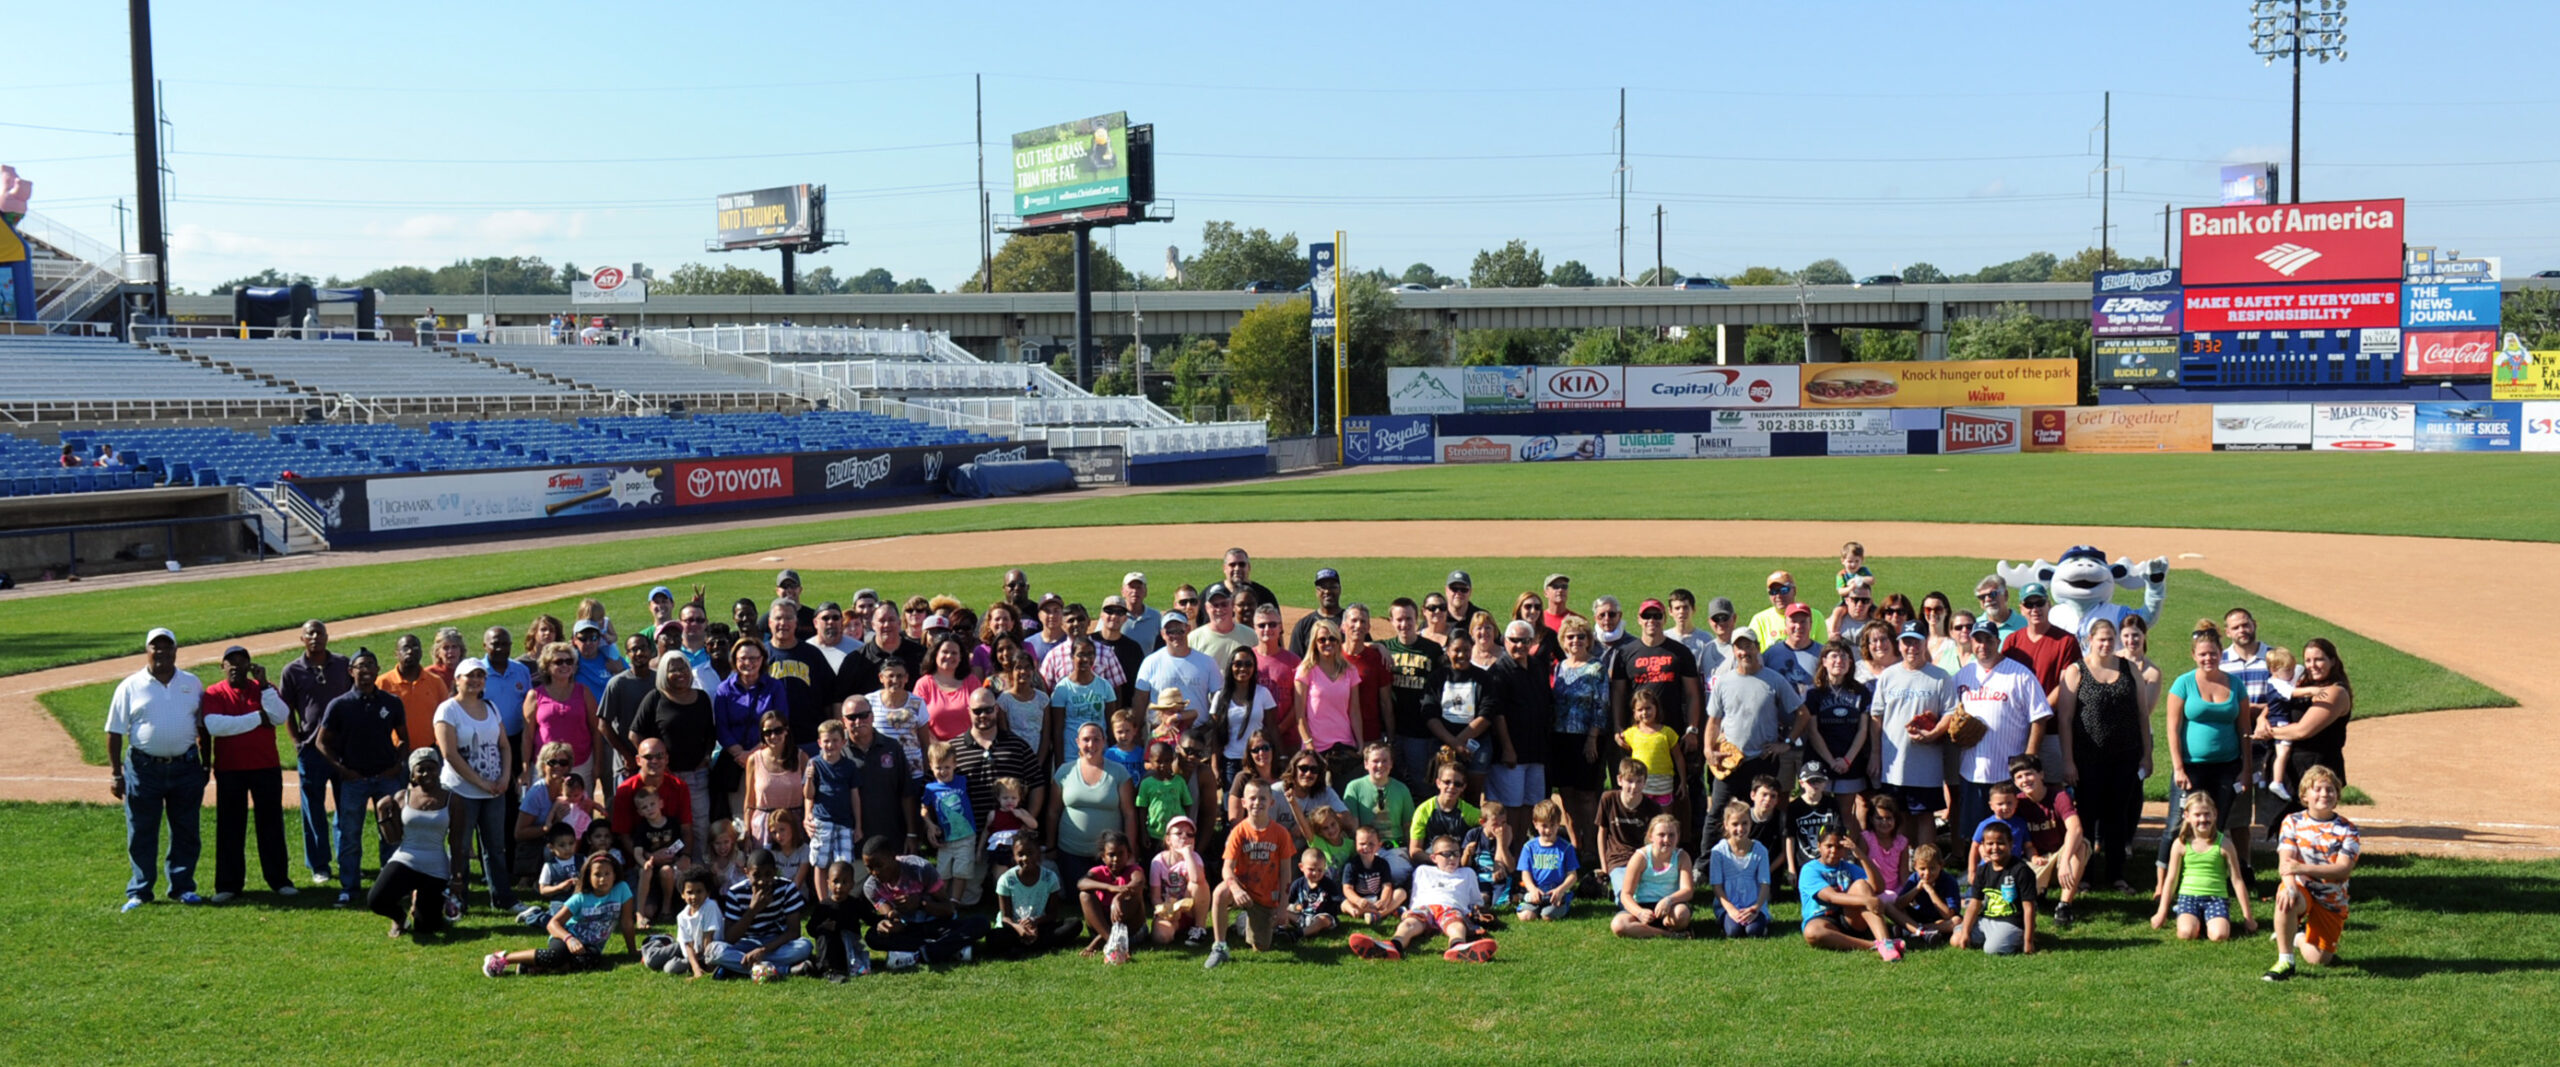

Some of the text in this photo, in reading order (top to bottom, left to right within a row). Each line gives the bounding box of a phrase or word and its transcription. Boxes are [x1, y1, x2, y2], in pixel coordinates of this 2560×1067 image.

[1016, 141, 1087, 169] CUT THE GRASS.
[1017, 163, 1078, 188] TRIM THE FAT.
[719, 203, 787, 231] INTO TRIUMPH.
[2189, 205, 2394, 236] Bank of America
[2435, 263, 2479, 273] MCM
[2101, 270, 2172, 291] BLUE ROCKS
[2411, 286, 2439, 298] THE
[2187, 292, 2395, 309] MAKE SAFETY EVERYONE'S
[2410, 298, 2452, 310] NEWS
[2108, 314, 2126, 325] Sign
[2140, 313, 2165, 323] Today
[2228, 308, 2352, 322] RESPONSIBILITY
[2408, 310, 2476, 325] JOURNAL
[2271, 331, 2289, 339] BALL
[2300, 330, 2325, 339] STRIKE
[2336, 329, 2351, 338] OUT
[2193, 339, 2222, 353] 3:32
[1466, 373, 1502, 385] MONEY
[1901, 366, 2072, 383] Knock hunger out of the park
[2114, 369, 2158, 377] BUCKLE UP
[1466, 384, 1502, 396] MAILER
[1559, 376, 1598, 392] KIA
[1750, 387, 1771, 396] 360
[1968, 389, 2005, 402] Wawa
[2077, 410, 2180, 428] Get Together!
[2330, 406, 2398, 421] MARLING'S
[1757, 419, 1856, 431] 302-838-6333
[2252, 416, 2309, 431] Cadillac
[2427, 423, 2511, 435] RULE THE SKIES.
[1374, 420, 1430, 451] Royals
[1950, 421, 2008, 443] HERR'S
[2034, 429, 2063, 437] Clarion
[1348, 434, 1368, 453] KC
[1619, 434, 1675, 447] UNIGLOBE
[1693, 435, 1732, 454] TANGENT
[1448, 447, 1507, 457] Stroehmann
[826, 453, 891, 489] BLUE ROCKS
[923, 450, 943, 480] W
[715, 467, 781, 492] TOYOTA
[380, 514, 419, 527] Delaware
[1635, 656, 1672, 668] GO FAST
[1957, 684, 2009, 702] Phillies
